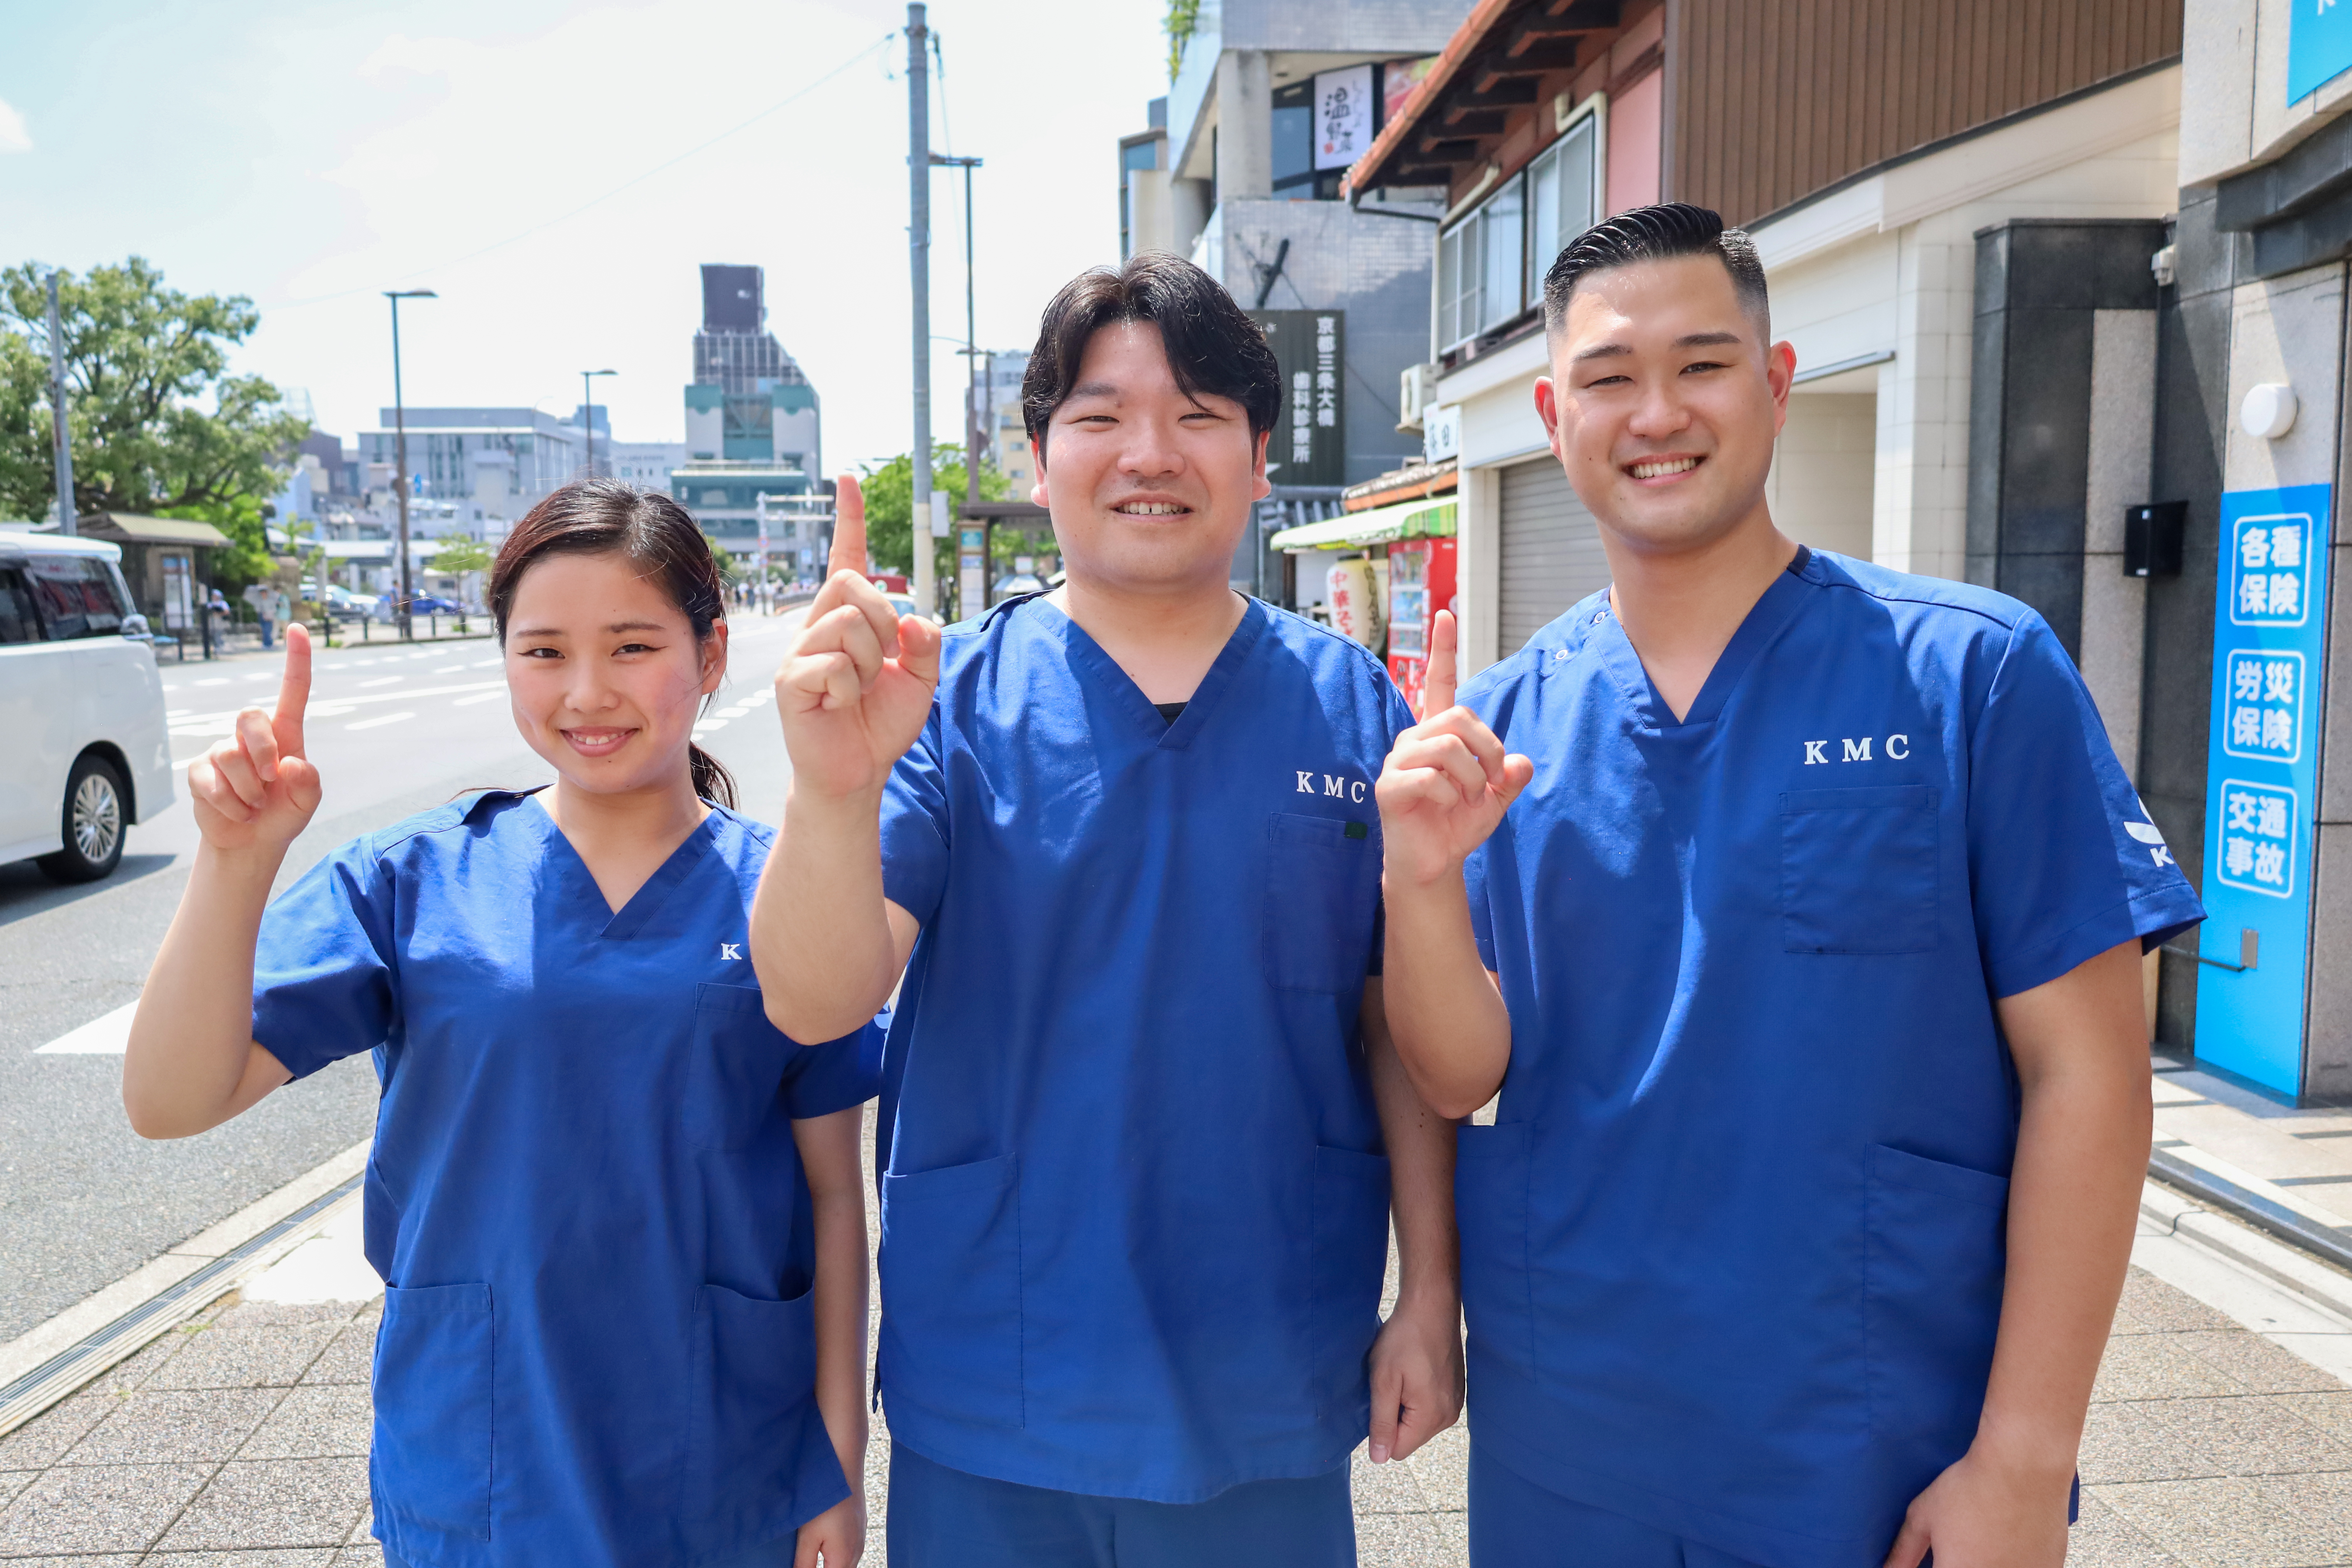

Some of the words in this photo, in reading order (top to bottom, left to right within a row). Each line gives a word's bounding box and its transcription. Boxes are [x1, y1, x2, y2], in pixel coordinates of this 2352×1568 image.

[1293, 371, 1310, 462] 歯科診療所
[2241, 525, 2301, 567] 各種
[2239, 573, 2299, 615] 保険
[2235, 660, 2293, 704] 労災
[1804, 734, 1909, 765] KMC
[2232, 706, 2292, 751] 保険
[1296, 771, 1366, 803] KMC
[2227, 791, 2287, 839] 交通
[2150, 846, 2174, 867] K
[2225, 836, 2285, 886] 事故
[721, 943, 742, 960] K
